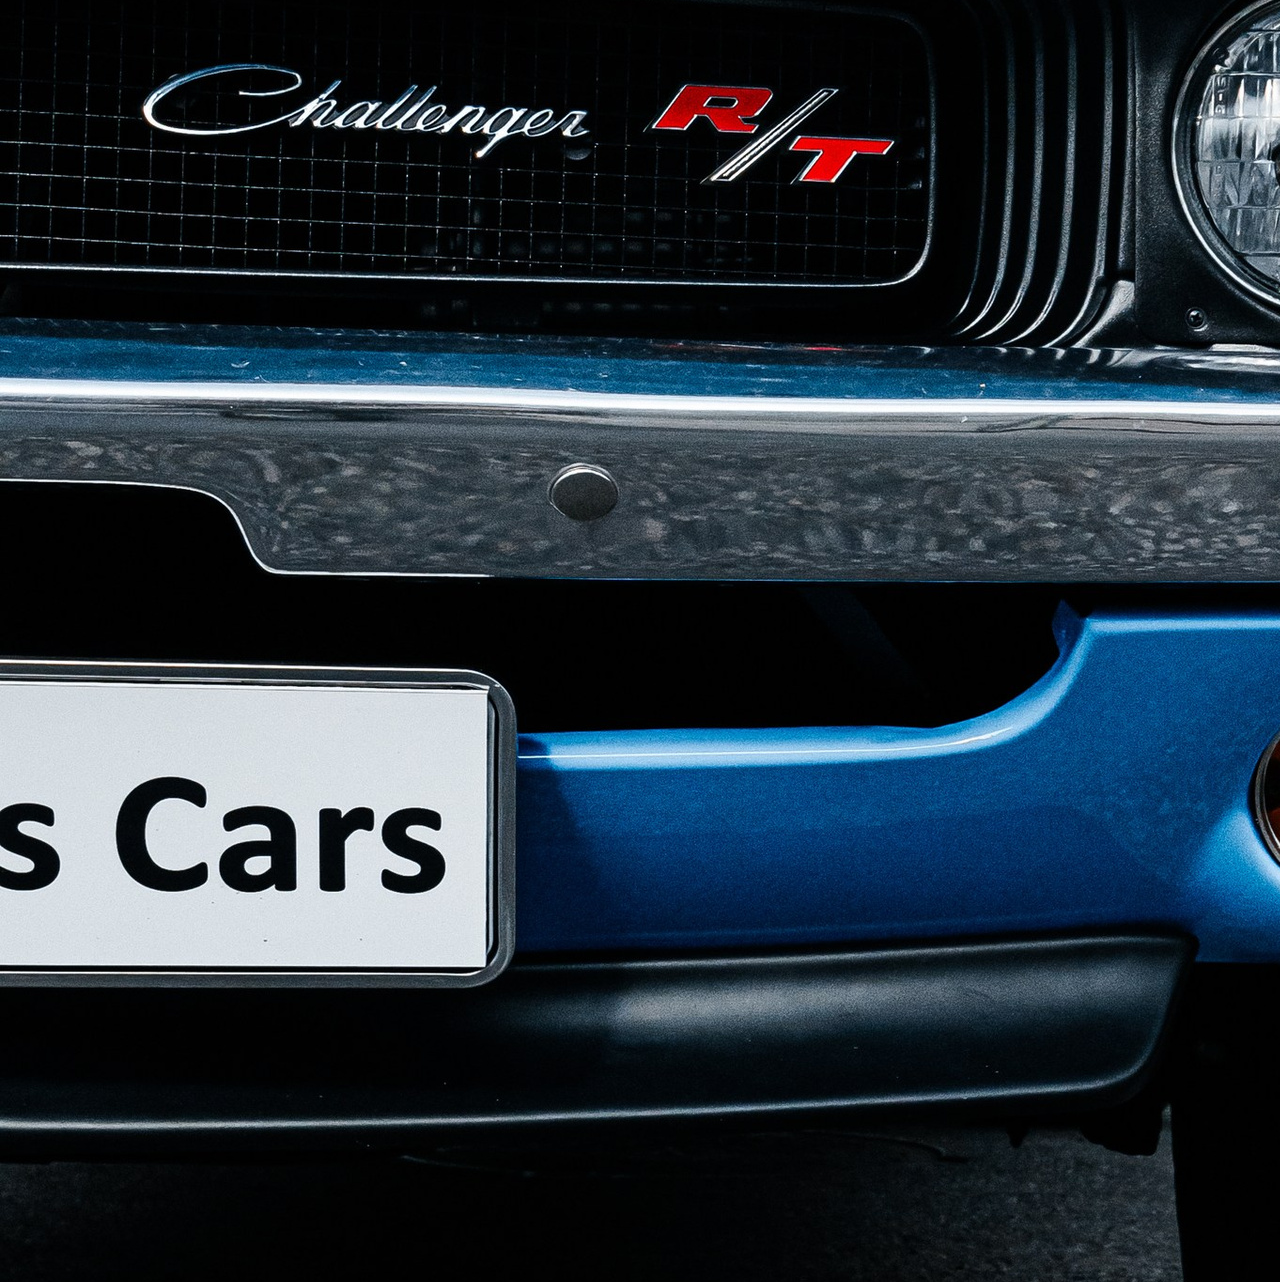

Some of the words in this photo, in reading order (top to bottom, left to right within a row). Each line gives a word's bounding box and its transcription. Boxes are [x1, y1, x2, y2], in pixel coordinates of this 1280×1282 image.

[142, 63, 590, 158] Challenger
[651, 83, 895, 184] R/T
[115, 776, 446, 894] Cars
